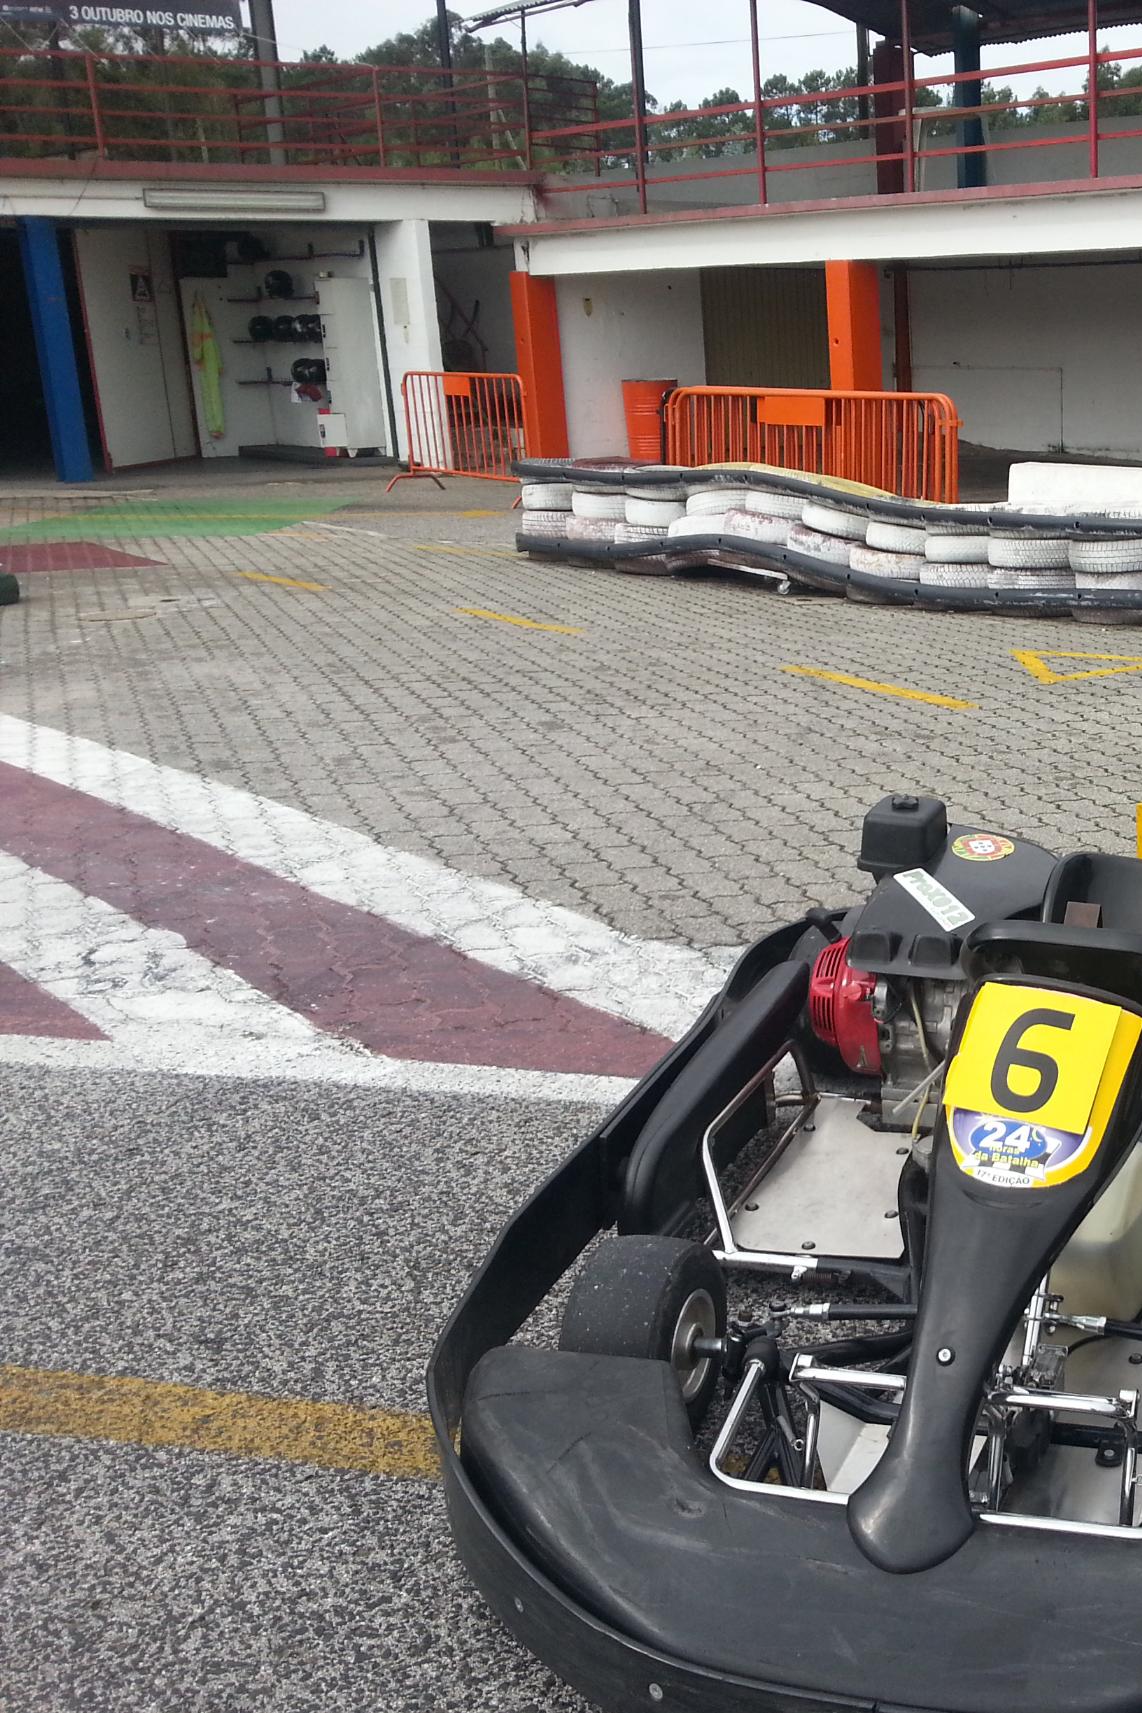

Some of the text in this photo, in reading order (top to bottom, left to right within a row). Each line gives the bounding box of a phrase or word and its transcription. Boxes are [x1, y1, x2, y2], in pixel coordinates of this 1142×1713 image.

[69, 5, 79, 20] 3
[81, 6, 144, 24] OUTUBRO
[146, 11, 175, 26] NOS
[176, 13, 234, 29] CINEMAS
[991, 1008, 1075, 1113] 6
[979, 1121, 1030, 1153] 24
[992, 1151, 1040, 1169] Batalha
